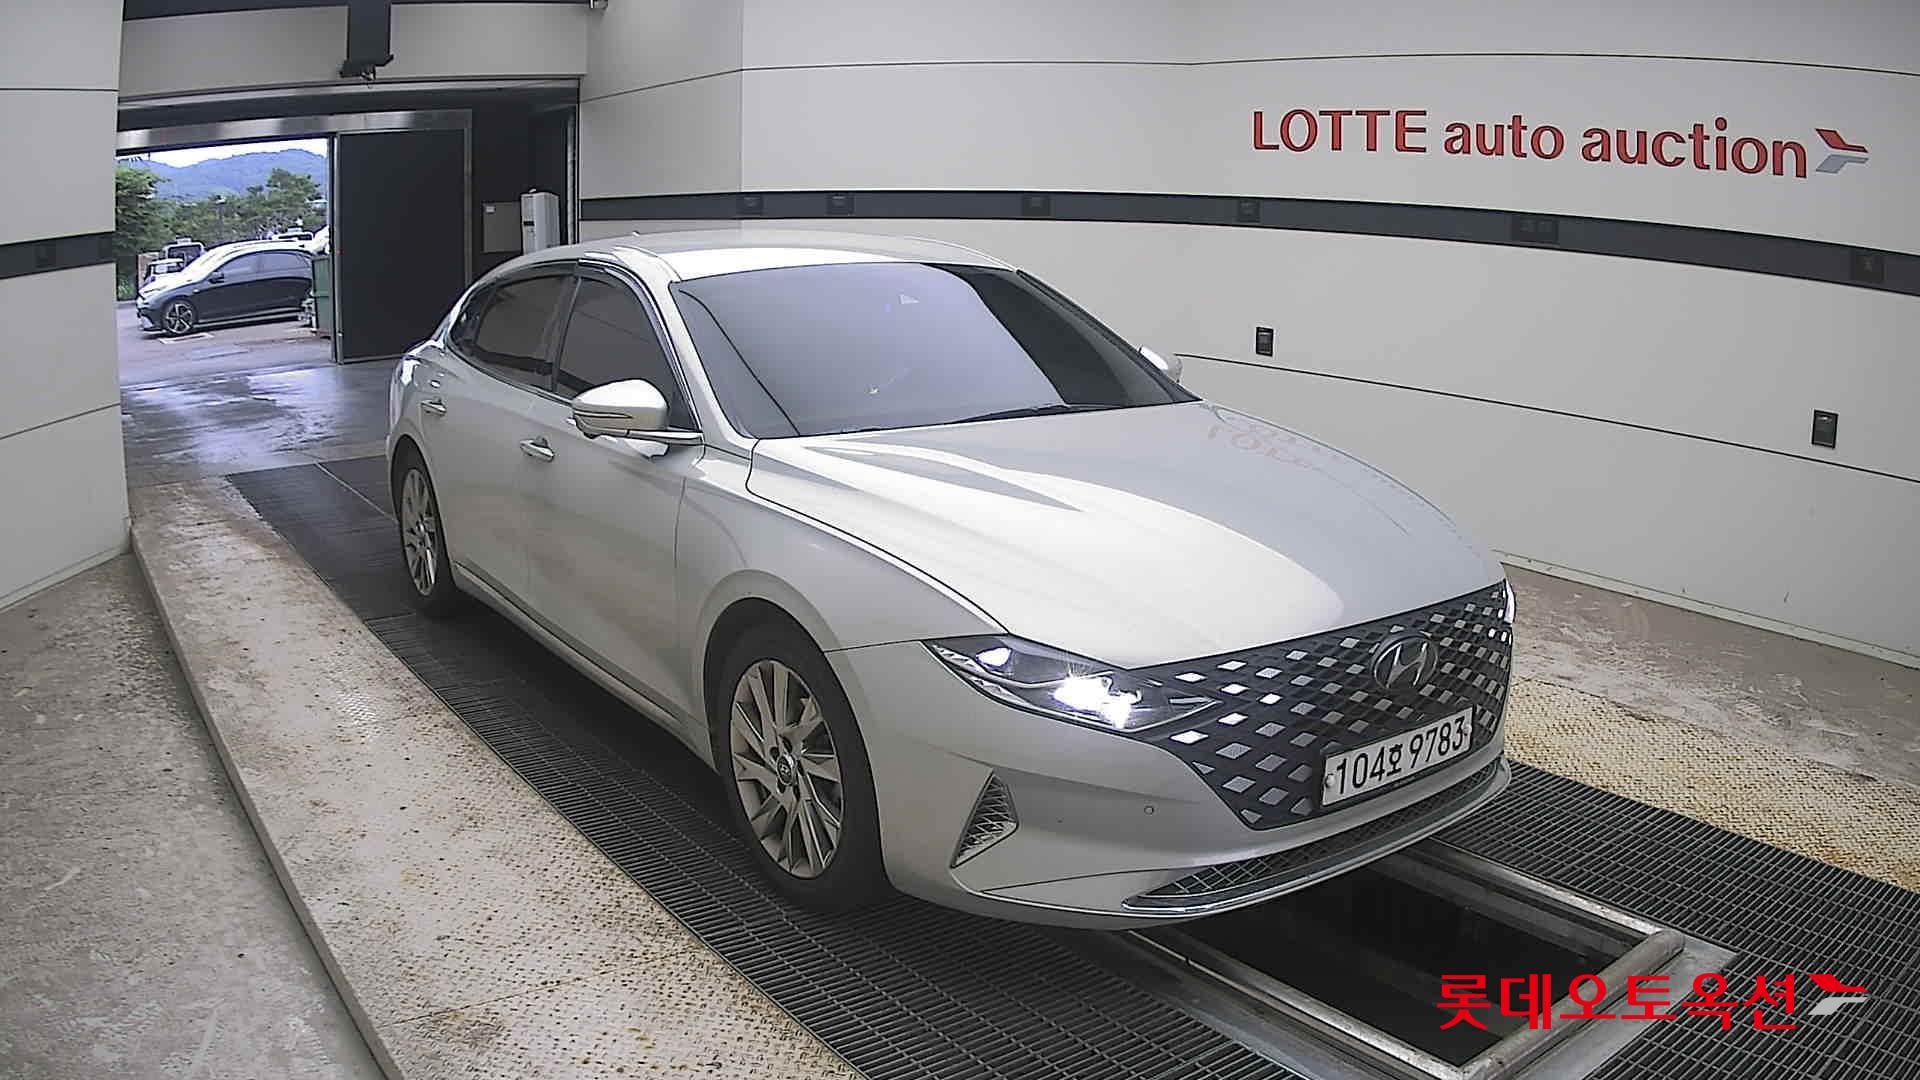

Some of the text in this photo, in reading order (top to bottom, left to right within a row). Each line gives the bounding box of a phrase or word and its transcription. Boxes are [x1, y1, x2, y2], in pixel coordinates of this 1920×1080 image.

[1252, 110, 1807, 179] LOTTE auto auction
[1408, 715, 1467, 769] 9783
